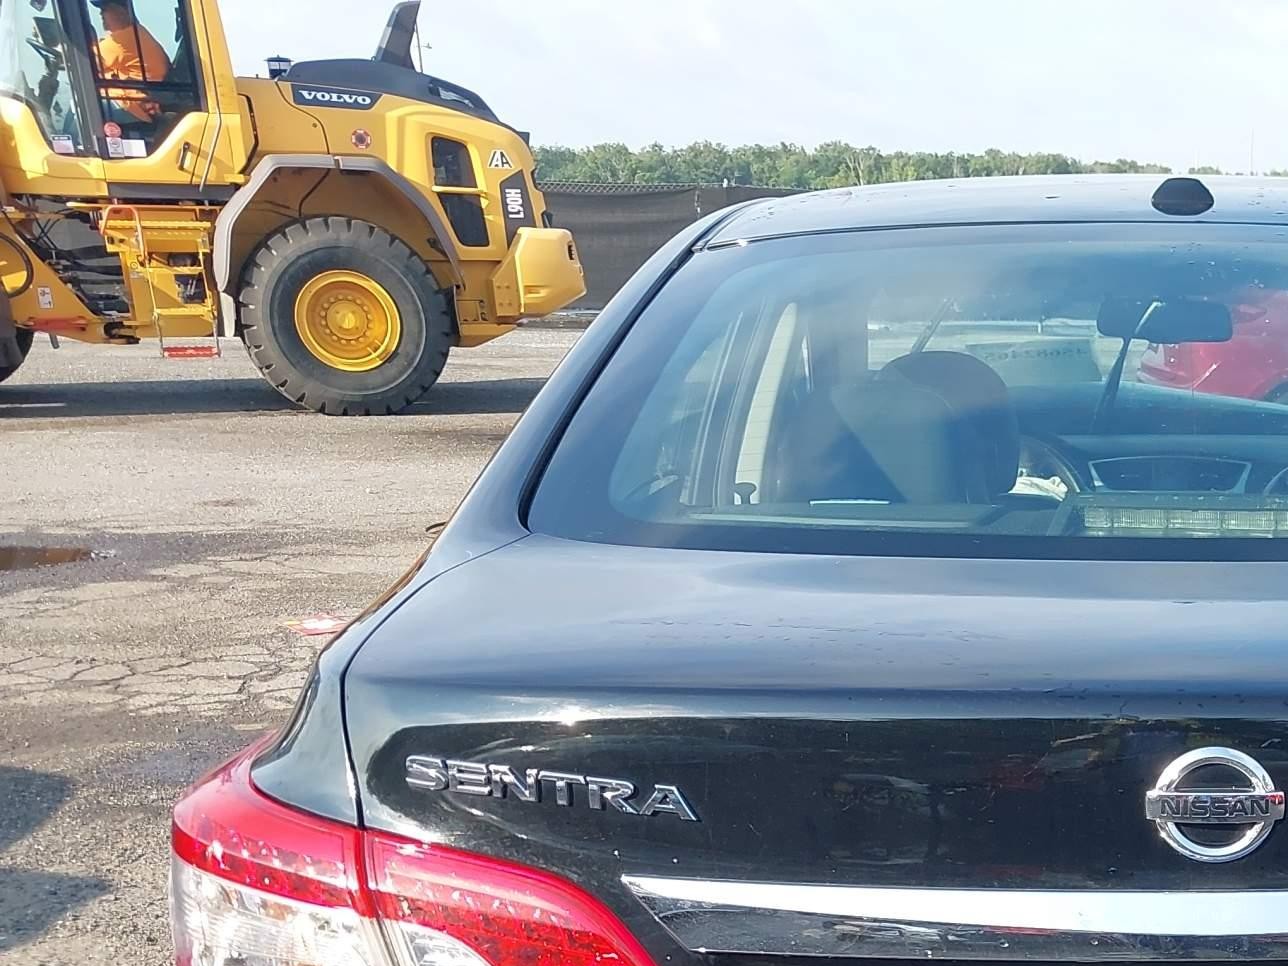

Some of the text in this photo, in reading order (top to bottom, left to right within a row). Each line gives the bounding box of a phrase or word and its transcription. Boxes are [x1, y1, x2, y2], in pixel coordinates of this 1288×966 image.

[298, 90, 372, 105] VOLVO
[505, 188, 524, 219] L90H
[405, 755, 701, 822] SENTRA
[1158, 795, 1271, 818] NISSAN
